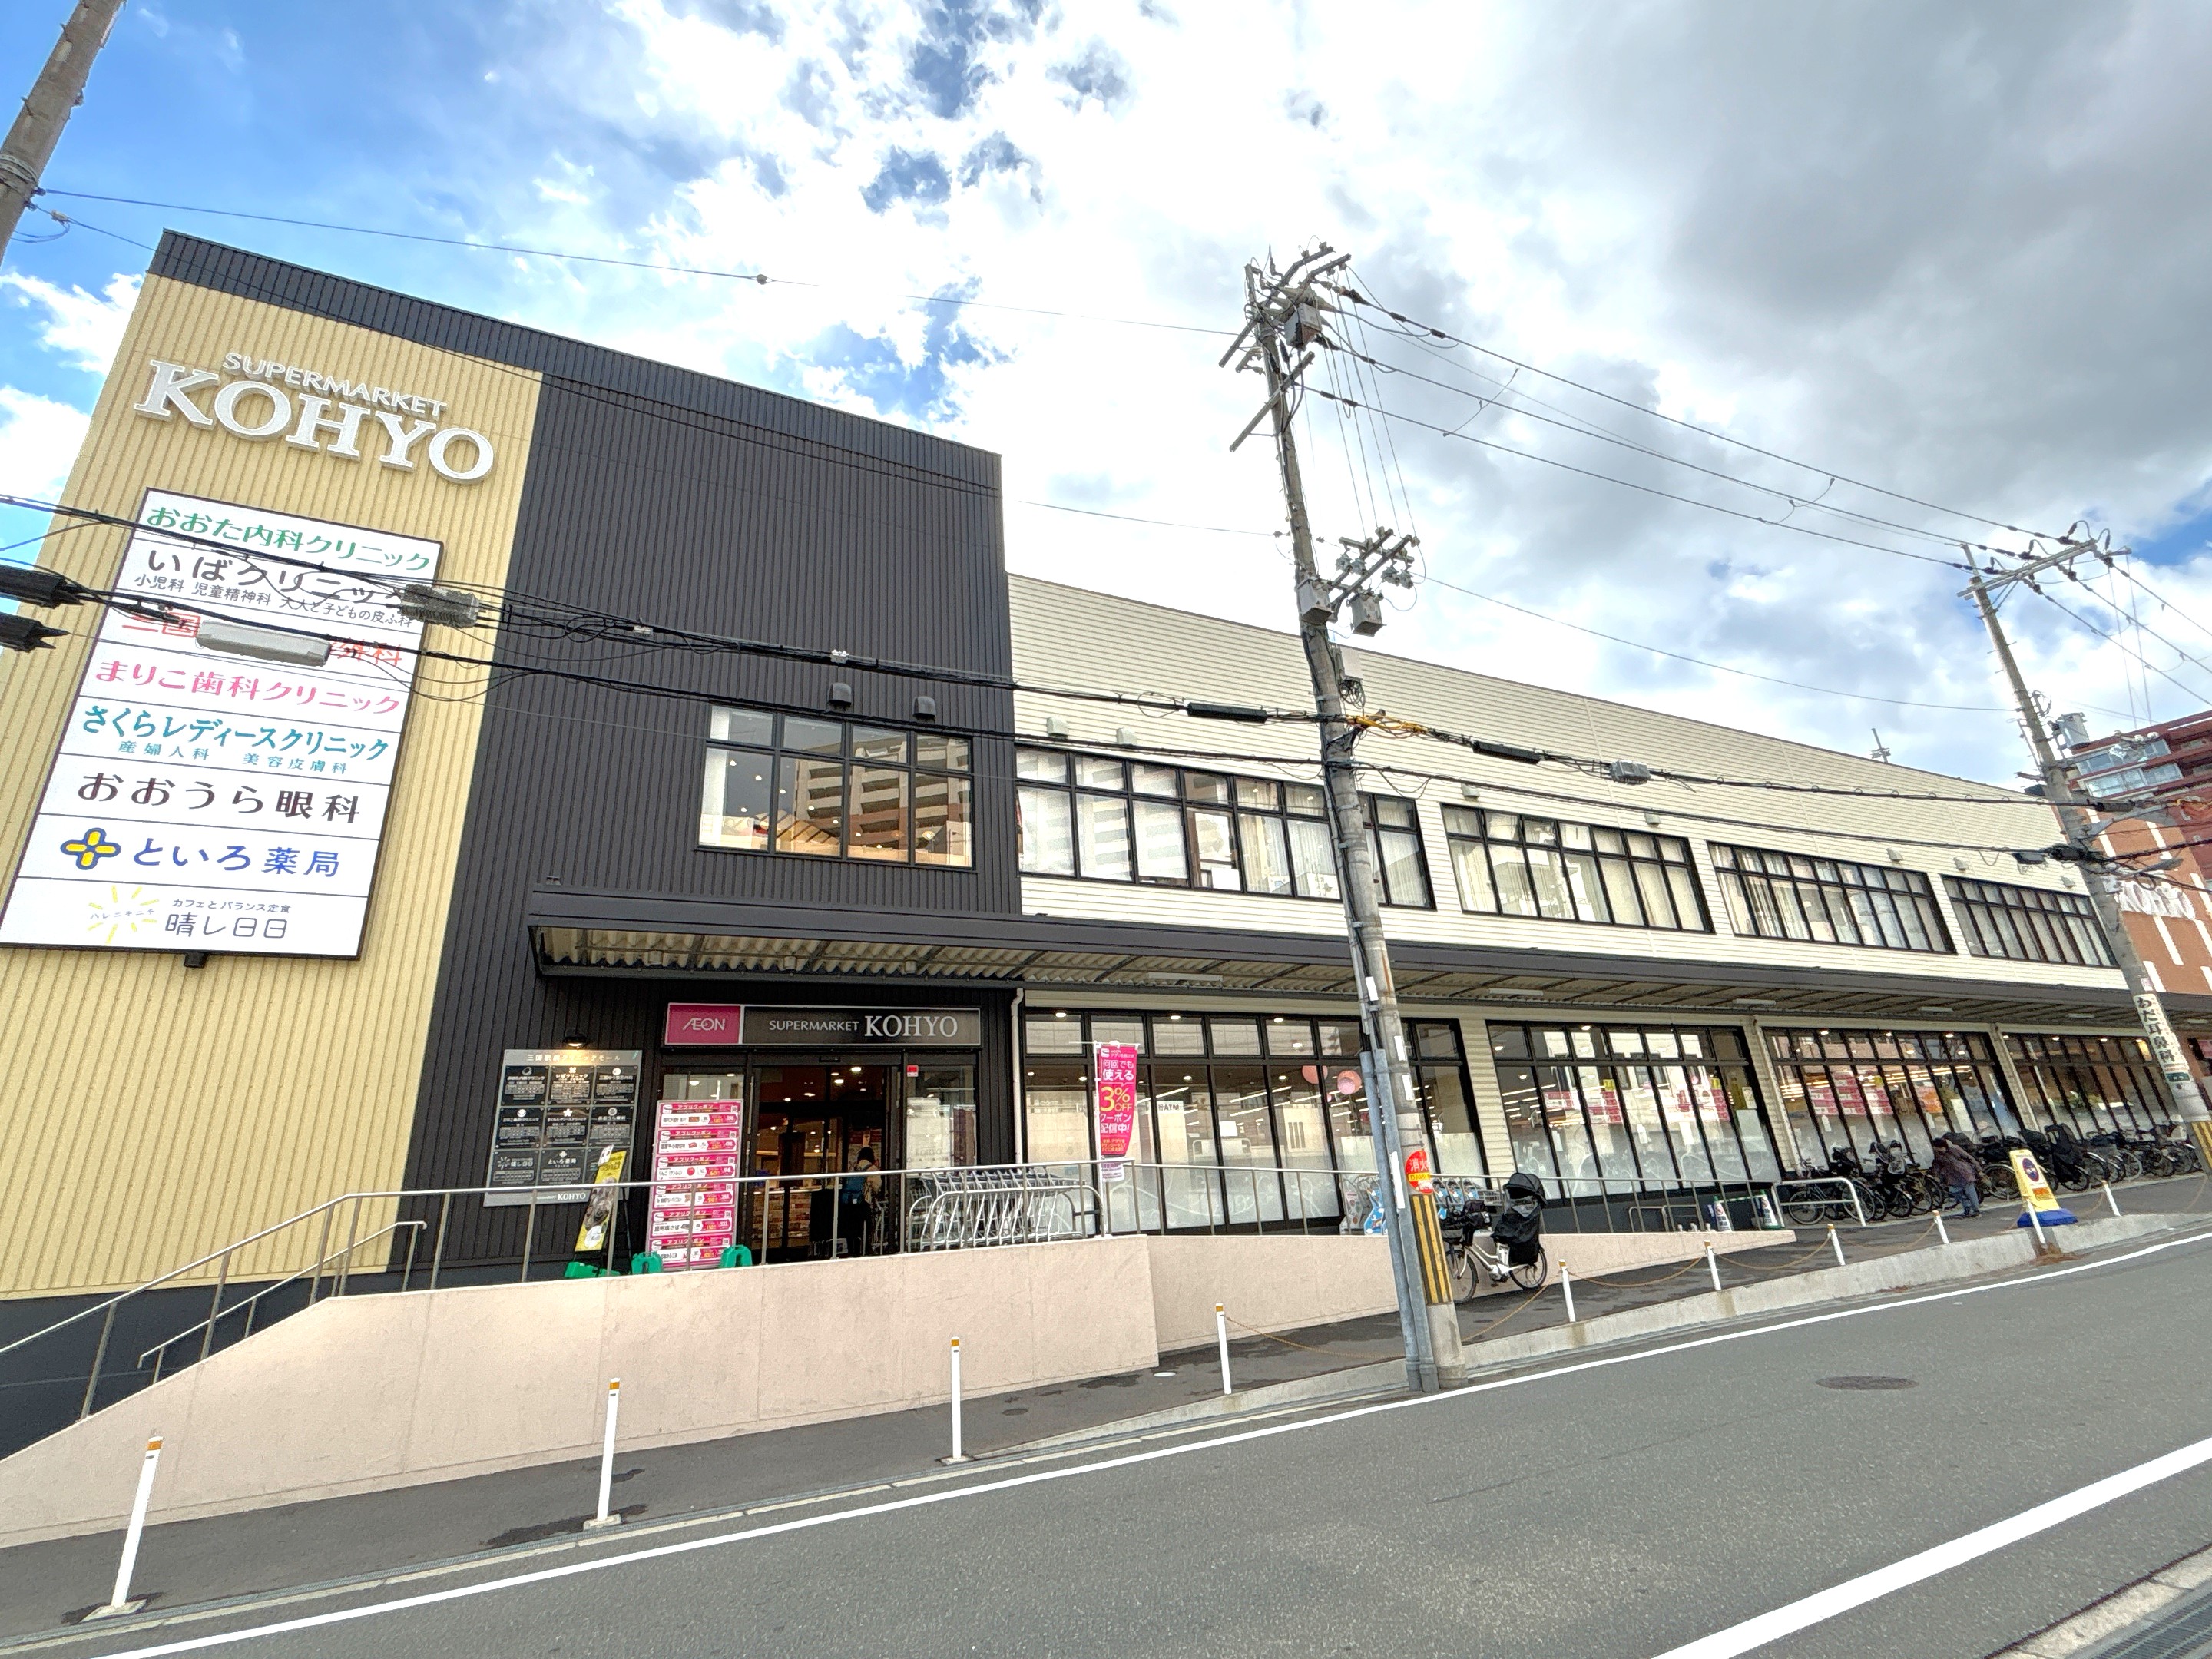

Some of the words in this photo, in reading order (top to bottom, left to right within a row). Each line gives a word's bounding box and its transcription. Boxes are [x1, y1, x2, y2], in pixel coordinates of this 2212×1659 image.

[223, 353, 447, 417] SUPERMARKET
[134, 359, 494, 485] KOHYO
[147, 507, 430, 571] おおた内科クリニック
[134, 574, 185, 593] 小児科
[191, 582, 273, 607] 児童精神科
[148, 549, 402, 604] いばクリニッ
[96, 661, 401, 714] まりこ歯科クリニック
[82, 704, 390, 762] さくらレディースクリニック
[118, 740, 210, 760] 産婦人科
[243, 753, 347, 774] 美容皮膚科
[77, 772, 361, 823] おおうら眼科
[134, 838, 340, 877] といろ薬局
[172, 899, 291, 914] カフェとバランス定食
[768, 1019, 860, 1032] SUPERMARKET
[864, 1015, 959, 1037] KOHYO
[1102, 1069, 1134, 1081] 使える
[1103, 1060, 1134, 1068] 何回でも
[1101, 1114, 1131, 1123] クーポン
[1114, 1104, 1133, 1112] OFF
[1101, 1123, 1130, 1134] 配信中!
